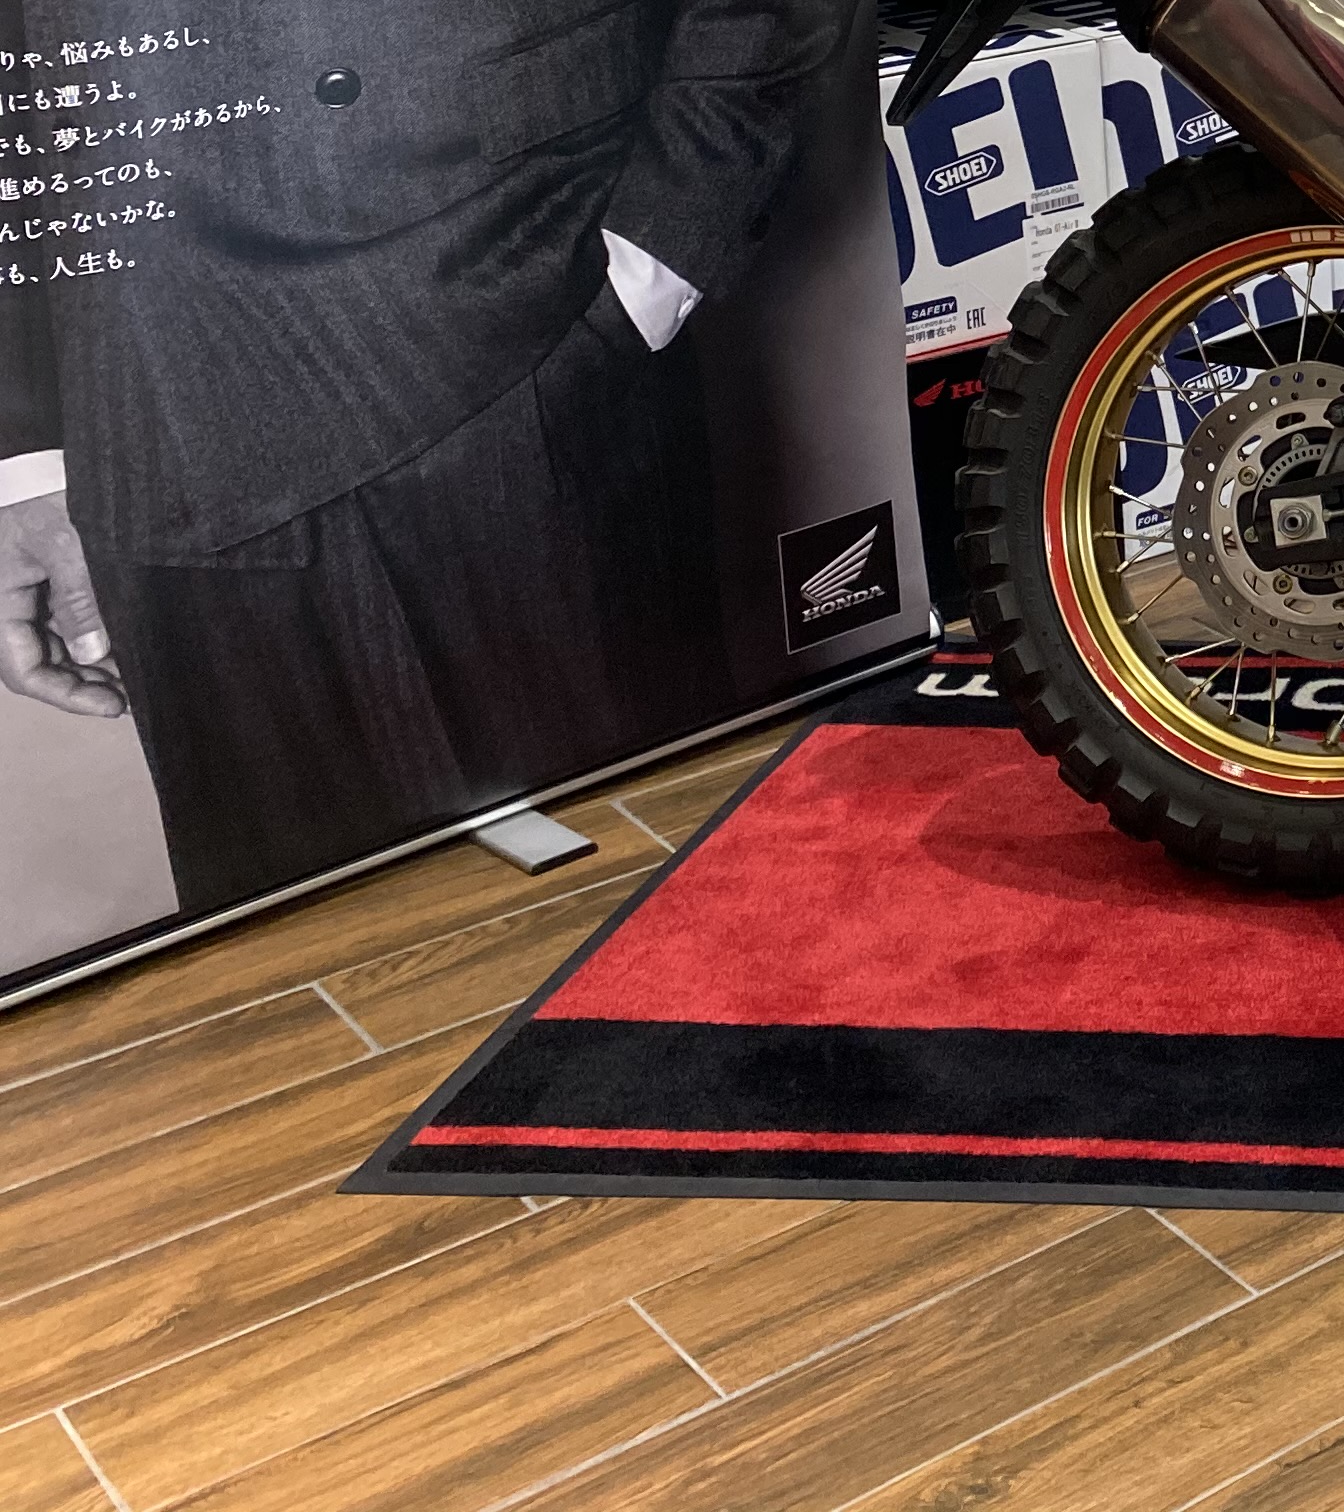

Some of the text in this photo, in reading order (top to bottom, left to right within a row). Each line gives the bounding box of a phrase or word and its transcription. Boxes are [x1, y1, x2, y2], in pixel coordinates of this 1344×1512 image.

[0, 80, 137, 116] にも遭うよ。
[934, 155, 988, 191] SHOEI
[0, 249, 136, 286] も、人生も。
[911, 301, 956, 320] SAFETY
[802, 584, 886, 623] HONDA
